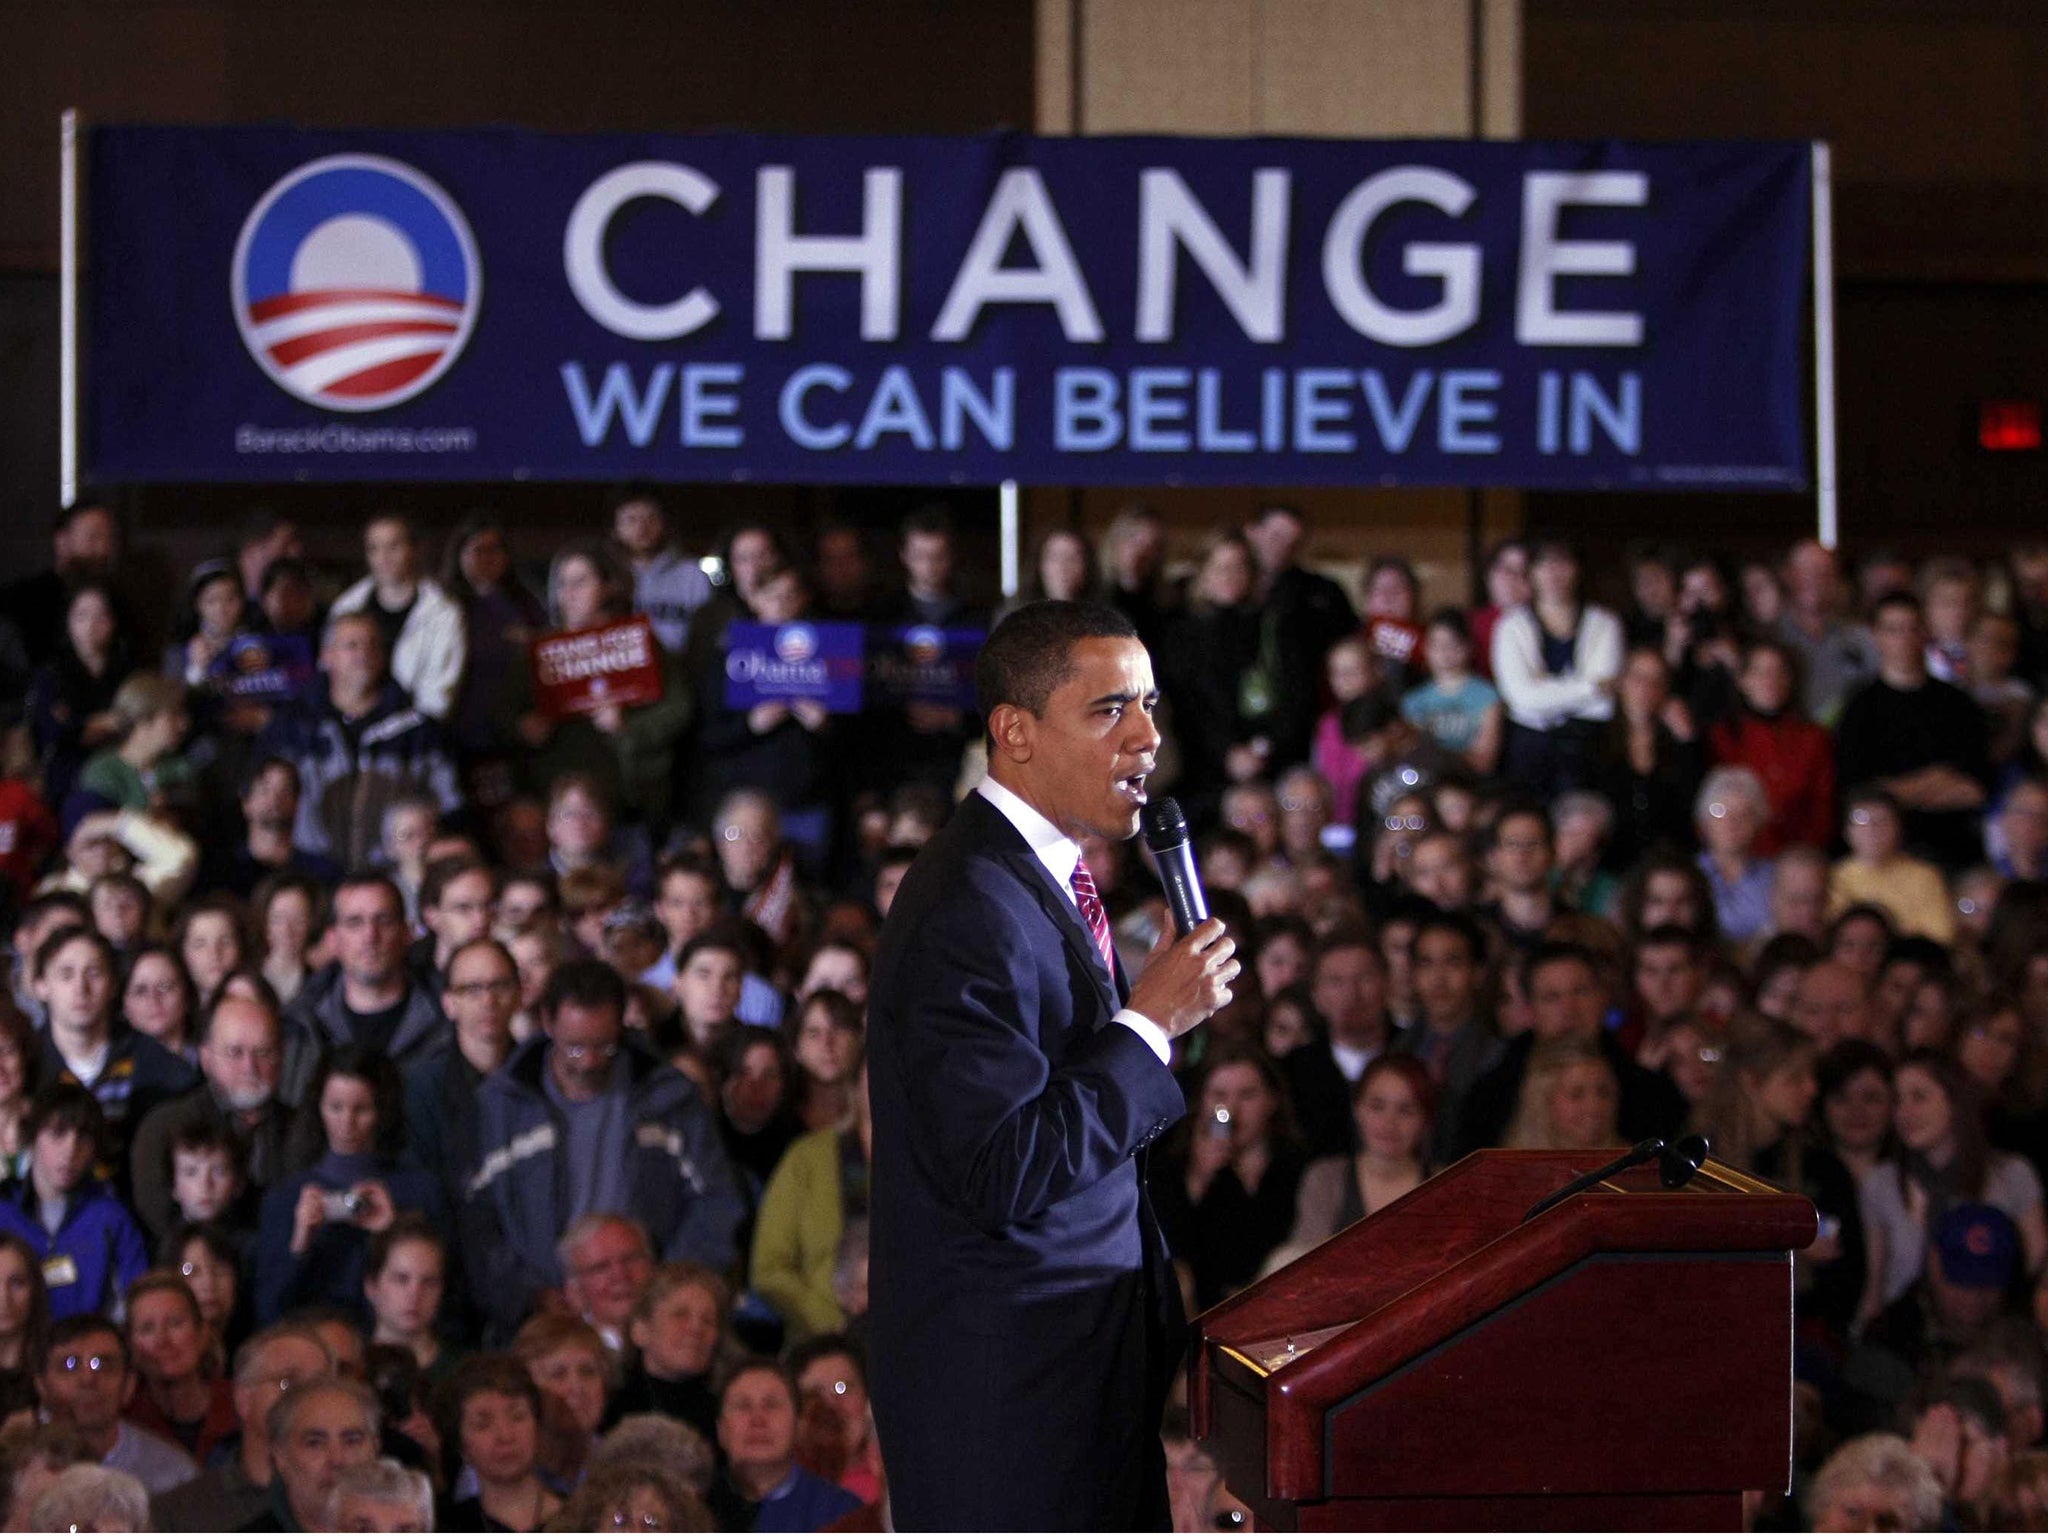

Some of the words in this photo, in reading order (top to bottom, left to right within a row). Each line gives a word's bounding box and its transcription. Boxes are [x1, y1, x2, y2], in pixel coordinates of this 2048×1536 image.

[564, 162, 1648, 346] CHANGE
[235, 423, 475, 453] BarackObama.com
[561, 363, 743, 447] WE
[779, 364, 1014, 451] CAN
[1054, 367, 1500, 453] BELIEVE
[1538, 372, 1641, 454] IN
